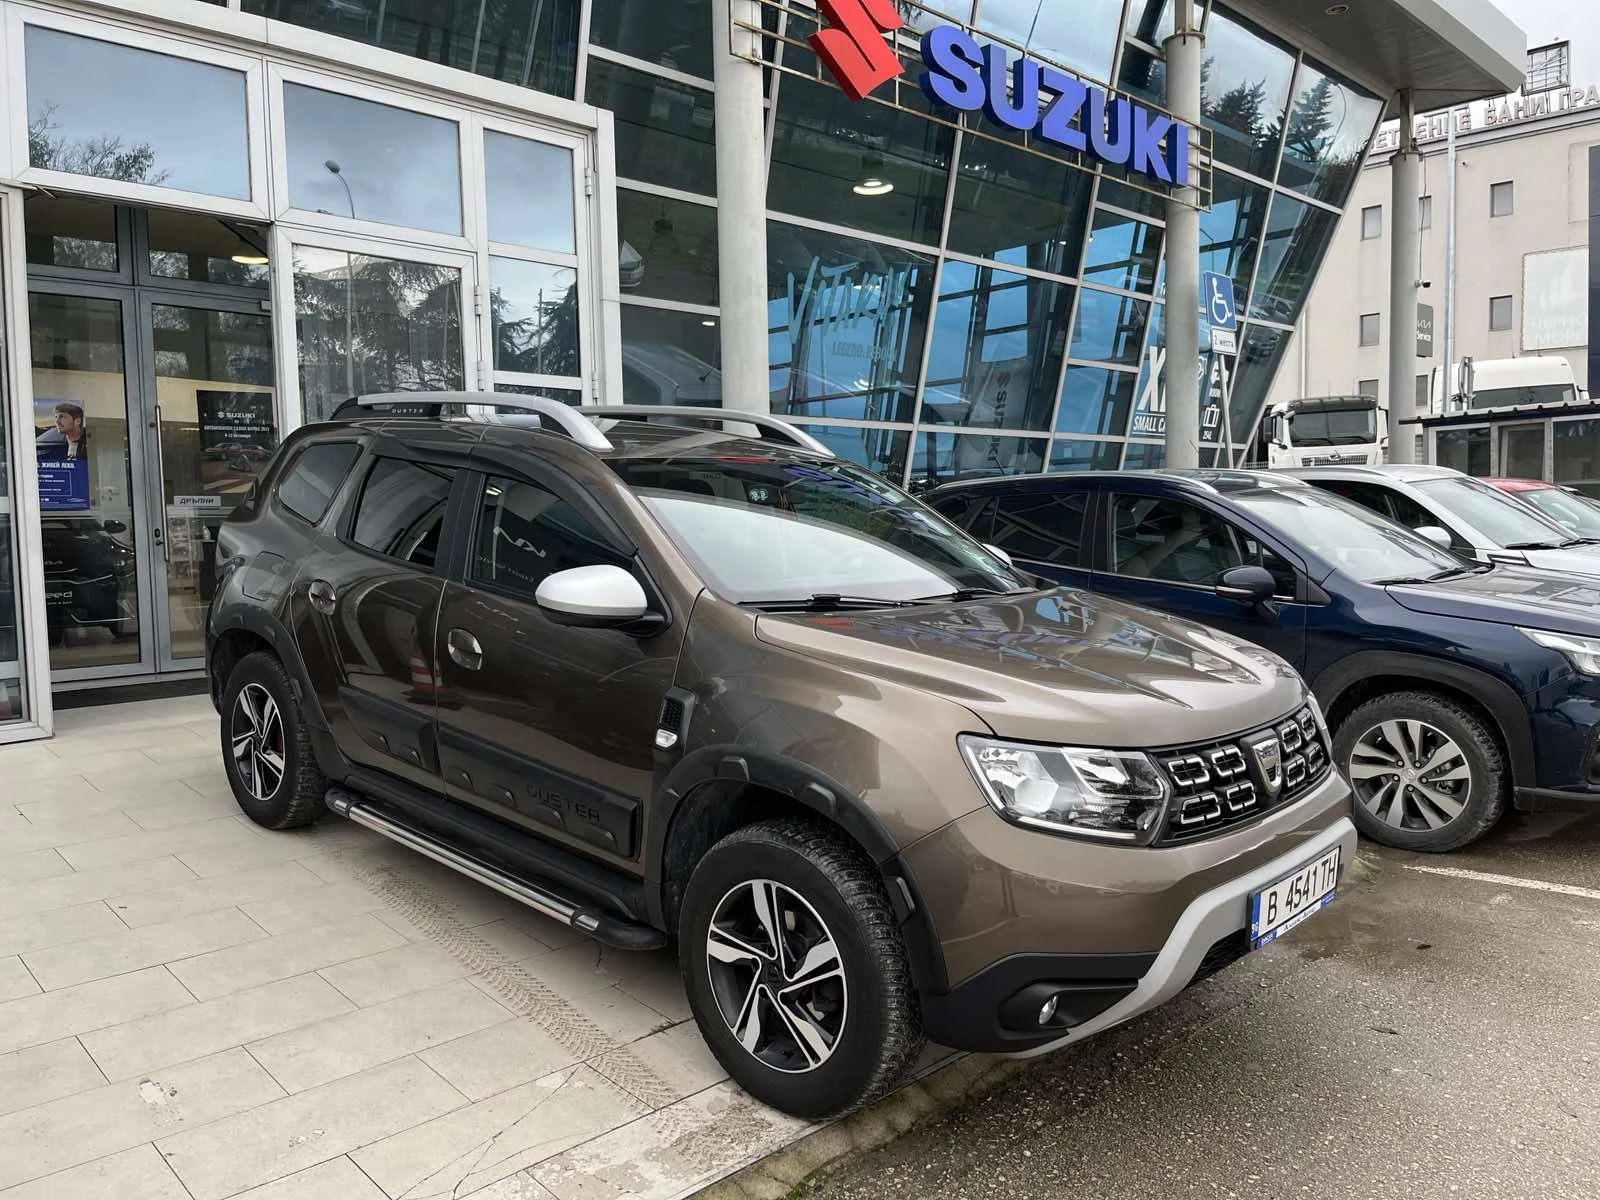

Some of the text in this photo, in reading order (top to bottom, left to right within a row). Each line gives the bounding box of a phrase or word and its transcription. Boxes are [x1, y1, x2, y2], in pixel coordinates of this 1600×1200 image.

[920, 25, 1188, 188] SUZUKI
[1484, 95, 1546, 125] БАНИ
[1133, 415, 1157, 432] SMALL
[526, 783, 600, 823] DUSTER
[1267, 853, 1337, 926] B 4541 TH
